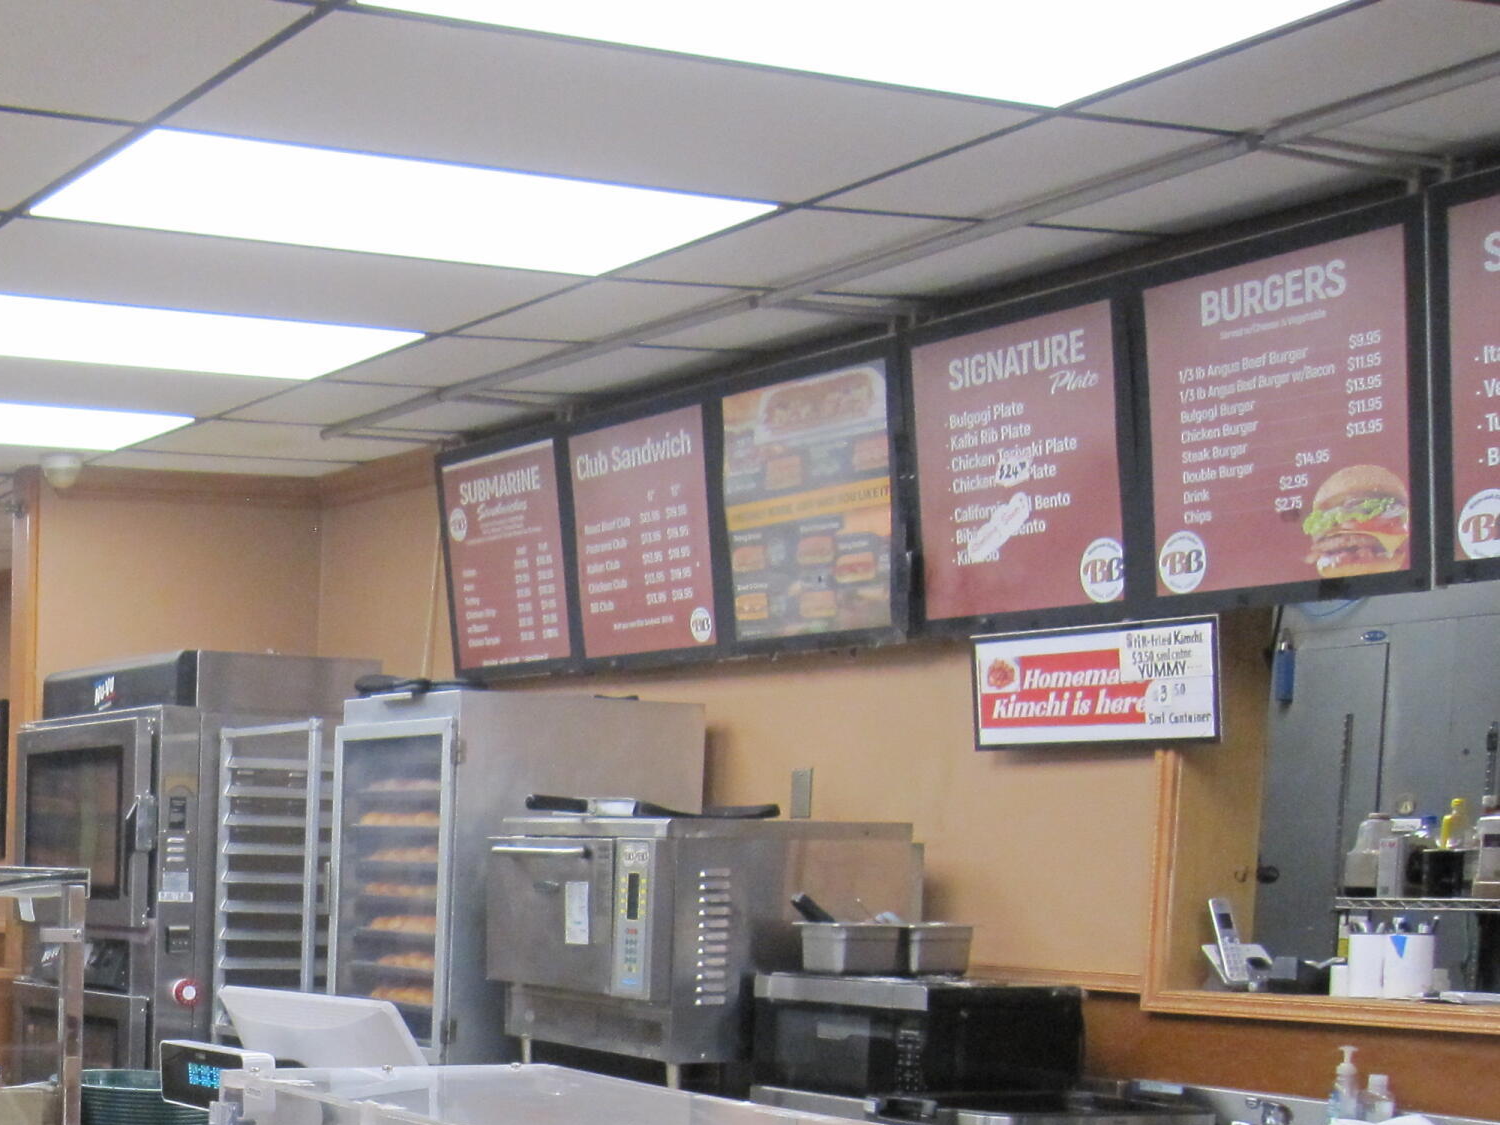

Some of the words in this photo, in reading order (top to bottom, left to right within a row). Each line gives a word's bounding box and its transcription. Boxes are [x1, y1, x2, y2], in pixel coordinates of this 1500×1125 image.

[1200, 259, 1347, 327] BURGERS
[1348, 330, 1381, 350] $9.95
[947, 329, 1086, 391] SIGNATURE
[1207, 362, 1240, 377] Angus
[1242, 353, 1266, 370] Beef
[1269, 348, 1308, 364] Burger
[1347, 353, 1381, 372] $11.95
[1049, 371, 1099, 395] Plate
[1208, 383, 1236, 399] Angus
[1236, 378, 1257, 392] Beef
[1258, 373, 1290, 388] Burger
[1292, 363, 1335, 383] w/Bacon
[1346, 375, 1382, 394] $13.95
[949, 406, 991, 430] Bulgogi
[993, 402, 1024, 421] Plate
[1180, 405, 1217, 424] Bulgogi
[1219, 400, 1256, 416] Burger
[1348, 397, 1382, 416] $11.95
[950, 430, 978, 452] Kalbi
[980, 428, 998, 445] Rib
[1000, 422, 1031, 441] Plate
[1181, 427, 1221, 444] Chicken
[1222, 421, 1259, 438] Burger
[1346, 418, 1383, 438] $13.95
[576, 450, 609, 480] Club
[611, 428, 692, 472] Sandwich
[951, 453, 996, 472] Chicken
[1045, 436, 1077, 455] Plate
[1181, 450, 1211, 464] Steak
[1212, 442, 1248, 459] Burger
[1295, 449, 1330, 468] $14.95
[459, 465, 541, 505] SUBMARINE
[952, 475, 997, 494] Chicken
[1183, 469, 1217, 485] Double
[1219, 463, 1255, 481] Burger
[1279, 474, 1309, 491] $2.95
[1034, 492, 1071, 510] Bento
[1183, 490, 1210, 505] Drink
[1274, 496, 1303, 513] $2.75
[954, 501, 1001, 523] Californi
[1184, 510, 1212, 525] Chips
[1012, 519, 1046, 536] ento
[1023, 667, 1121, 689] Homema
[1138, 660, 1186, 679] YUMMY
[992, 691, 1067, 719] Kimchi
[1072, 690, 1091, 716] is
